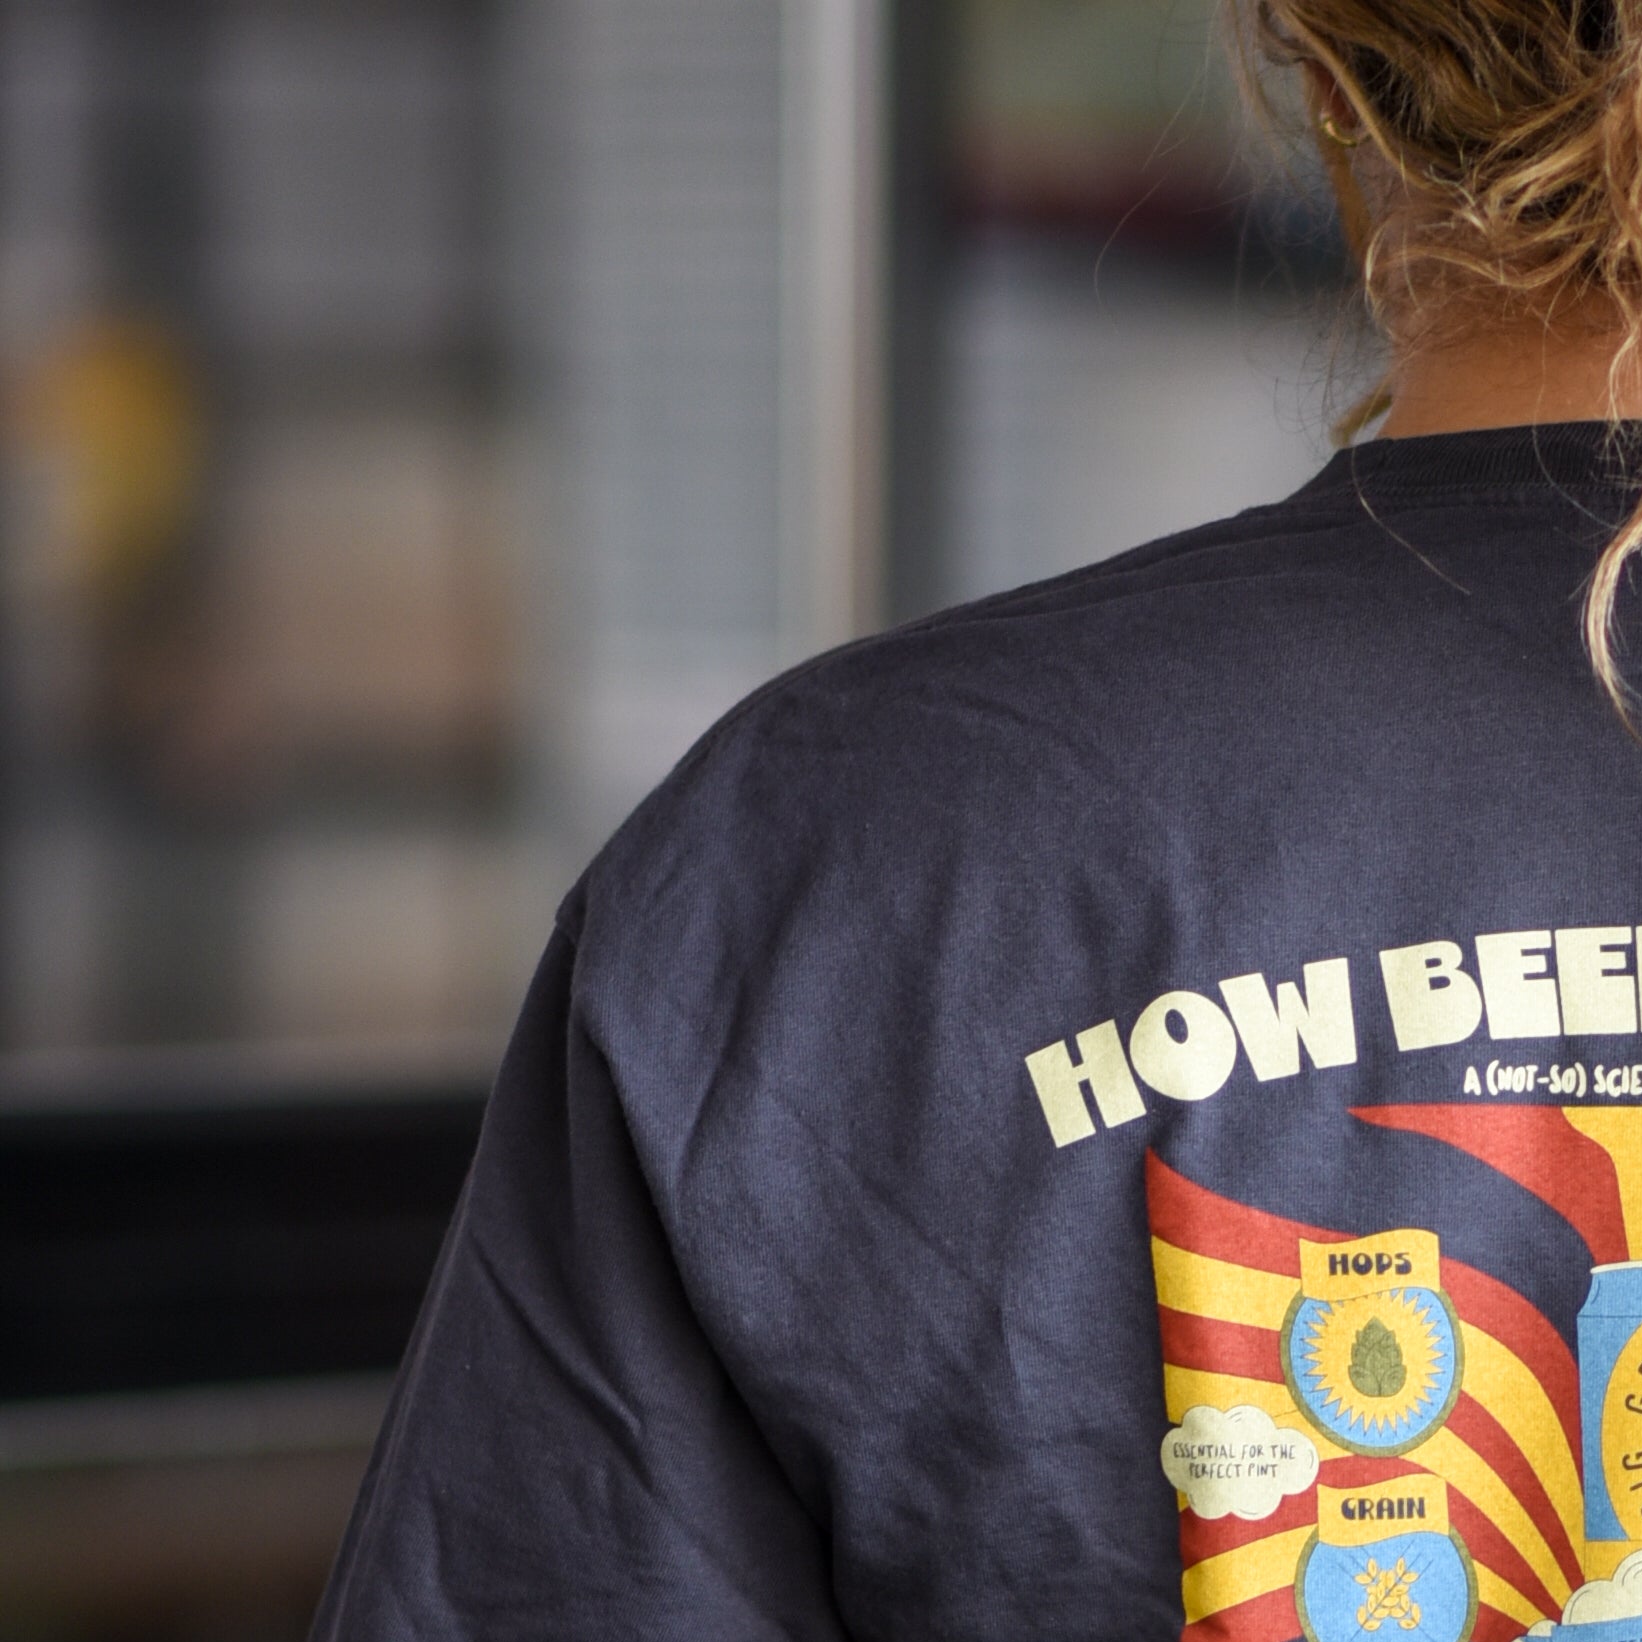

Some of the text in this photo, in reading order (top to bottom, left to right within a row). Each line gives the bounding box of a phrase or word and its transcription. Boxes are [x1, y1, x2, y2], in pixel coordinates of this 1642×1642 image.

[1025, 958, 1357, 1148] HOW
[1463, 1066, 1481, 1095] A
[1486, 1059, 1587, 1097] (NOT-SO)
[1328, 1252, 1412, 1276] HOPS
[1173, 1442, 1296, 1461] ESSENTIAL FOR THE
[1188, 1462, 1278, 1479] PERFECT PINT
[1341, 1497, 1426, 1520] GRAIN
